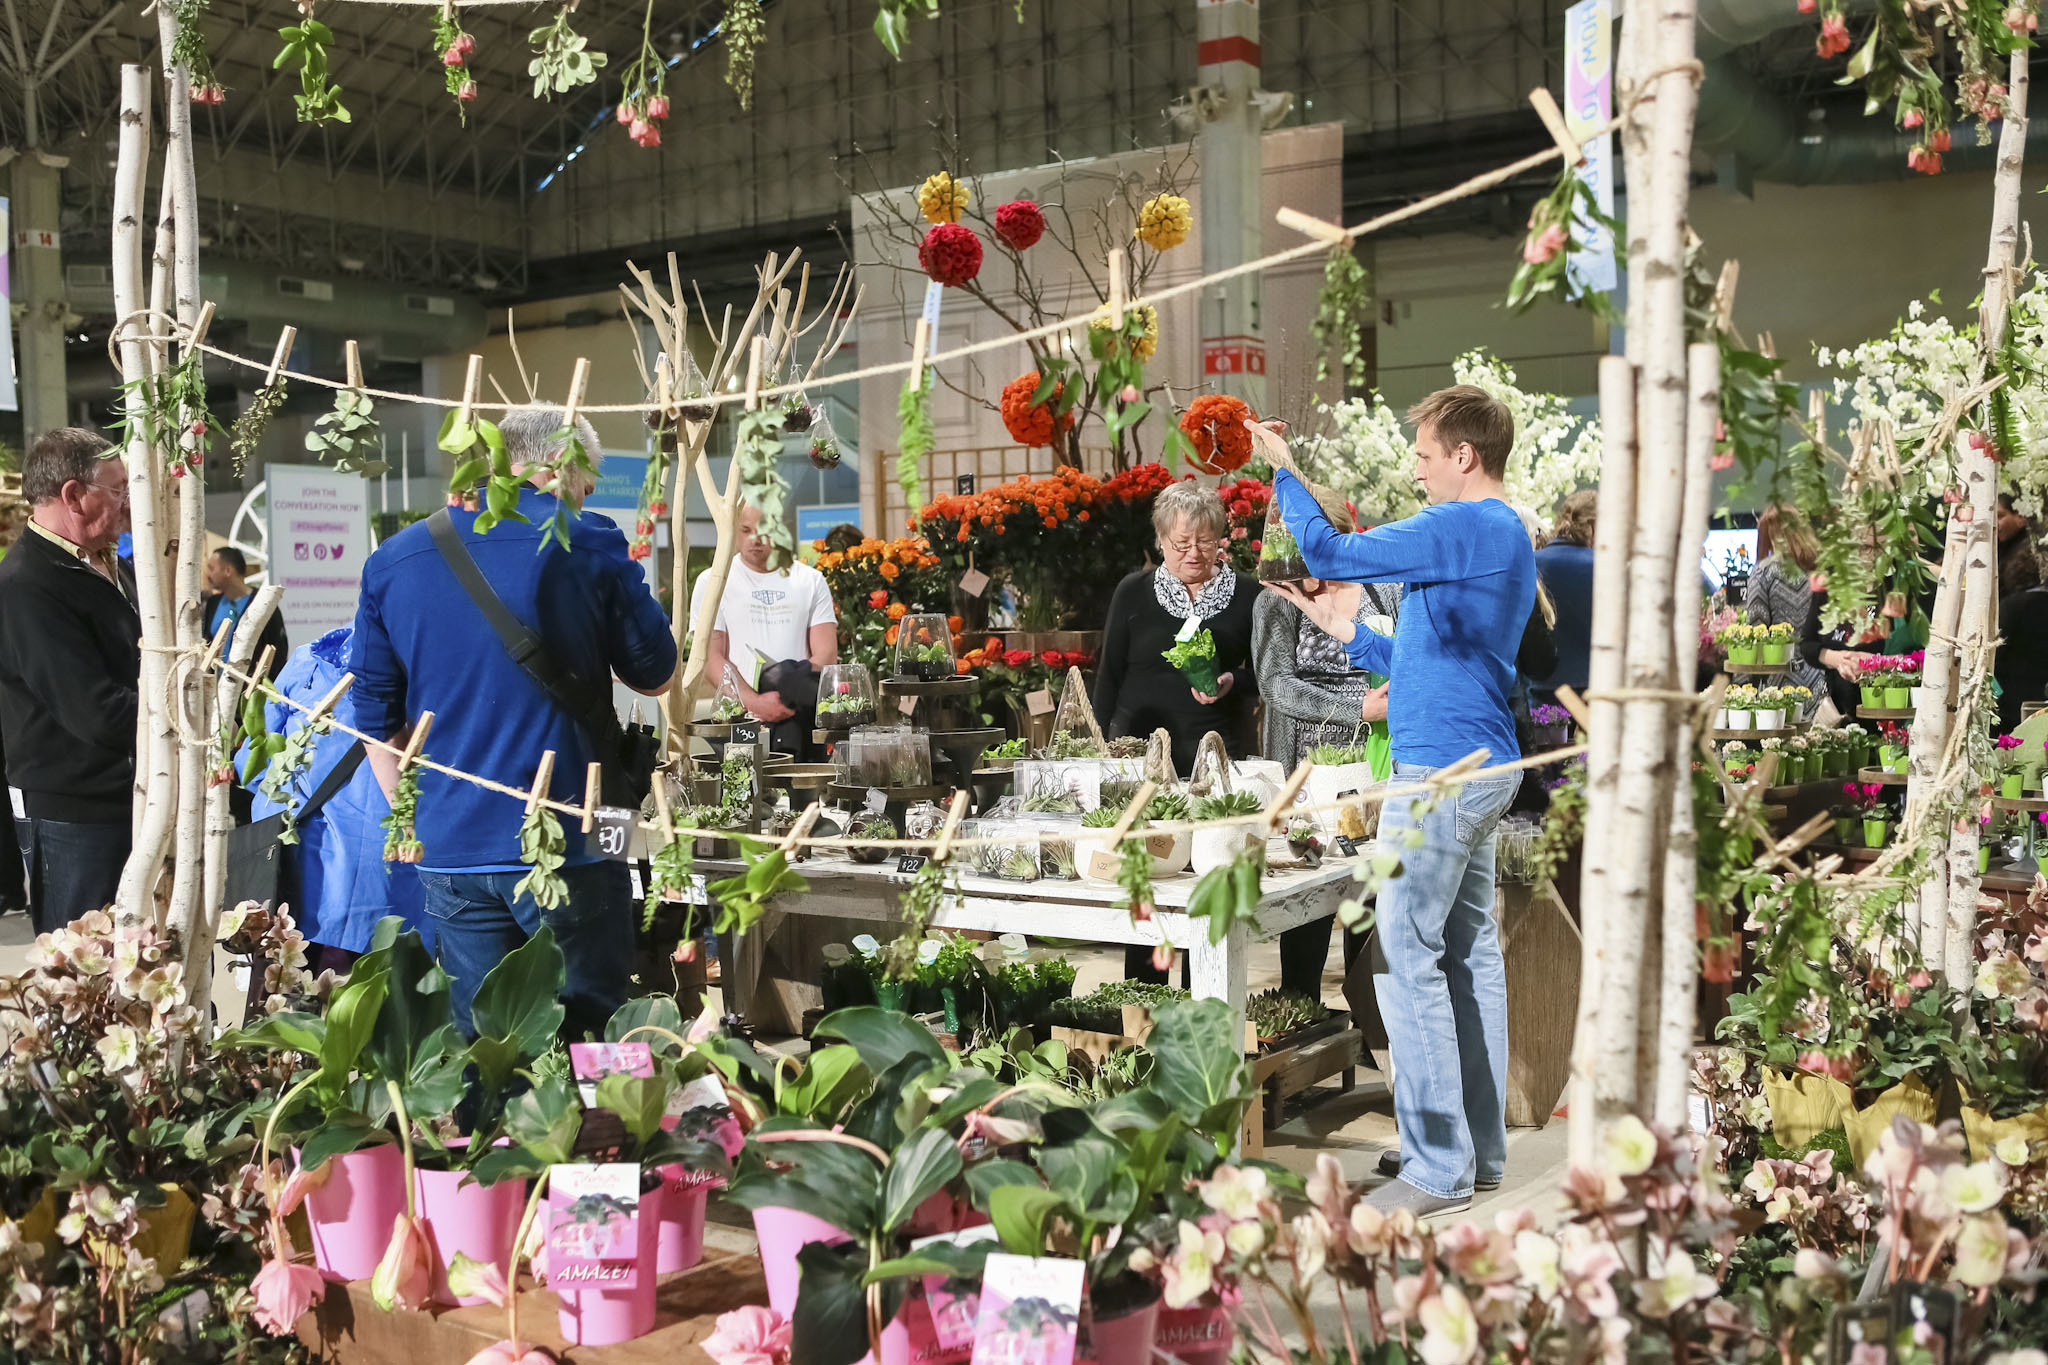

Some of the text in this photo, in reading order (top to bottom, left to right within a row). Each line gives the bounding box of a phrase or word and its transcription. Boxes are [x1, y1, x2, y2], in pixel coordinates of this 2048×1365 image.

[1582, 1, 1599, 245] HOW TO GARN
[274, 500, 338, 511] CONVERSATION
[902, 859, 919, 872] $22
